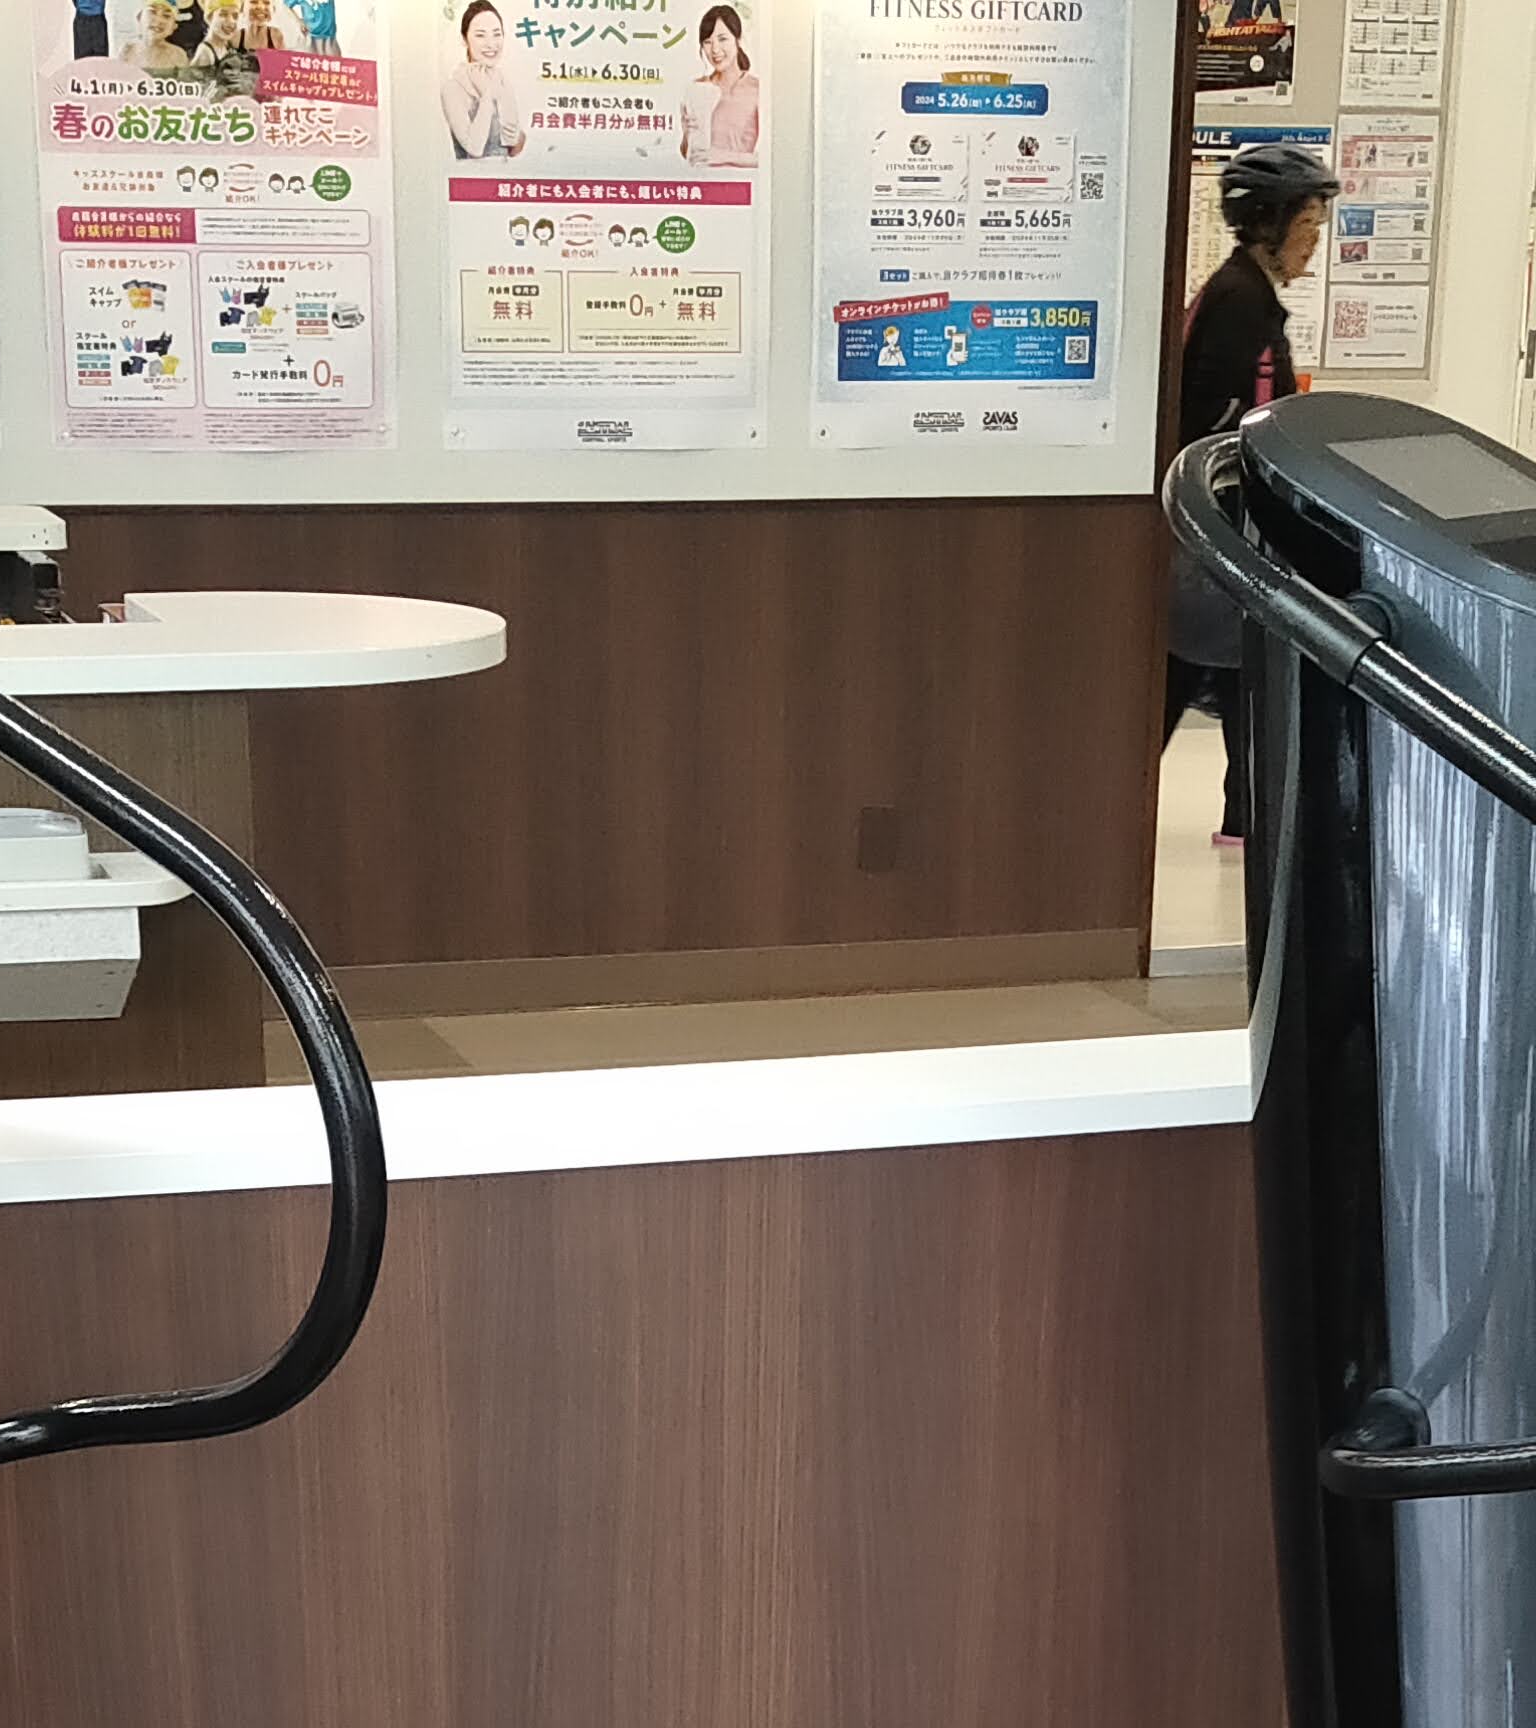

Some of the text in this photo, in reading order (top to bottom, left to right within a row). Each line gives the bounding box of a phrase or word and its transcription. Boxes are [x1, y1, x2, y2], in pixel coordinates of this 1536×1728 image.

[515, 17, 688, 49] キャンペーン
[52, 104, 256, 143] 春のお友だち
[264, 106, 333, 124] 連れてこ
[265, 126, 368, 145] キャンペーン
[492, 300, 534, 321] 無料
[677, 301, 716, 321] 無料
[983, 411, 1018, 425] SAVAS
